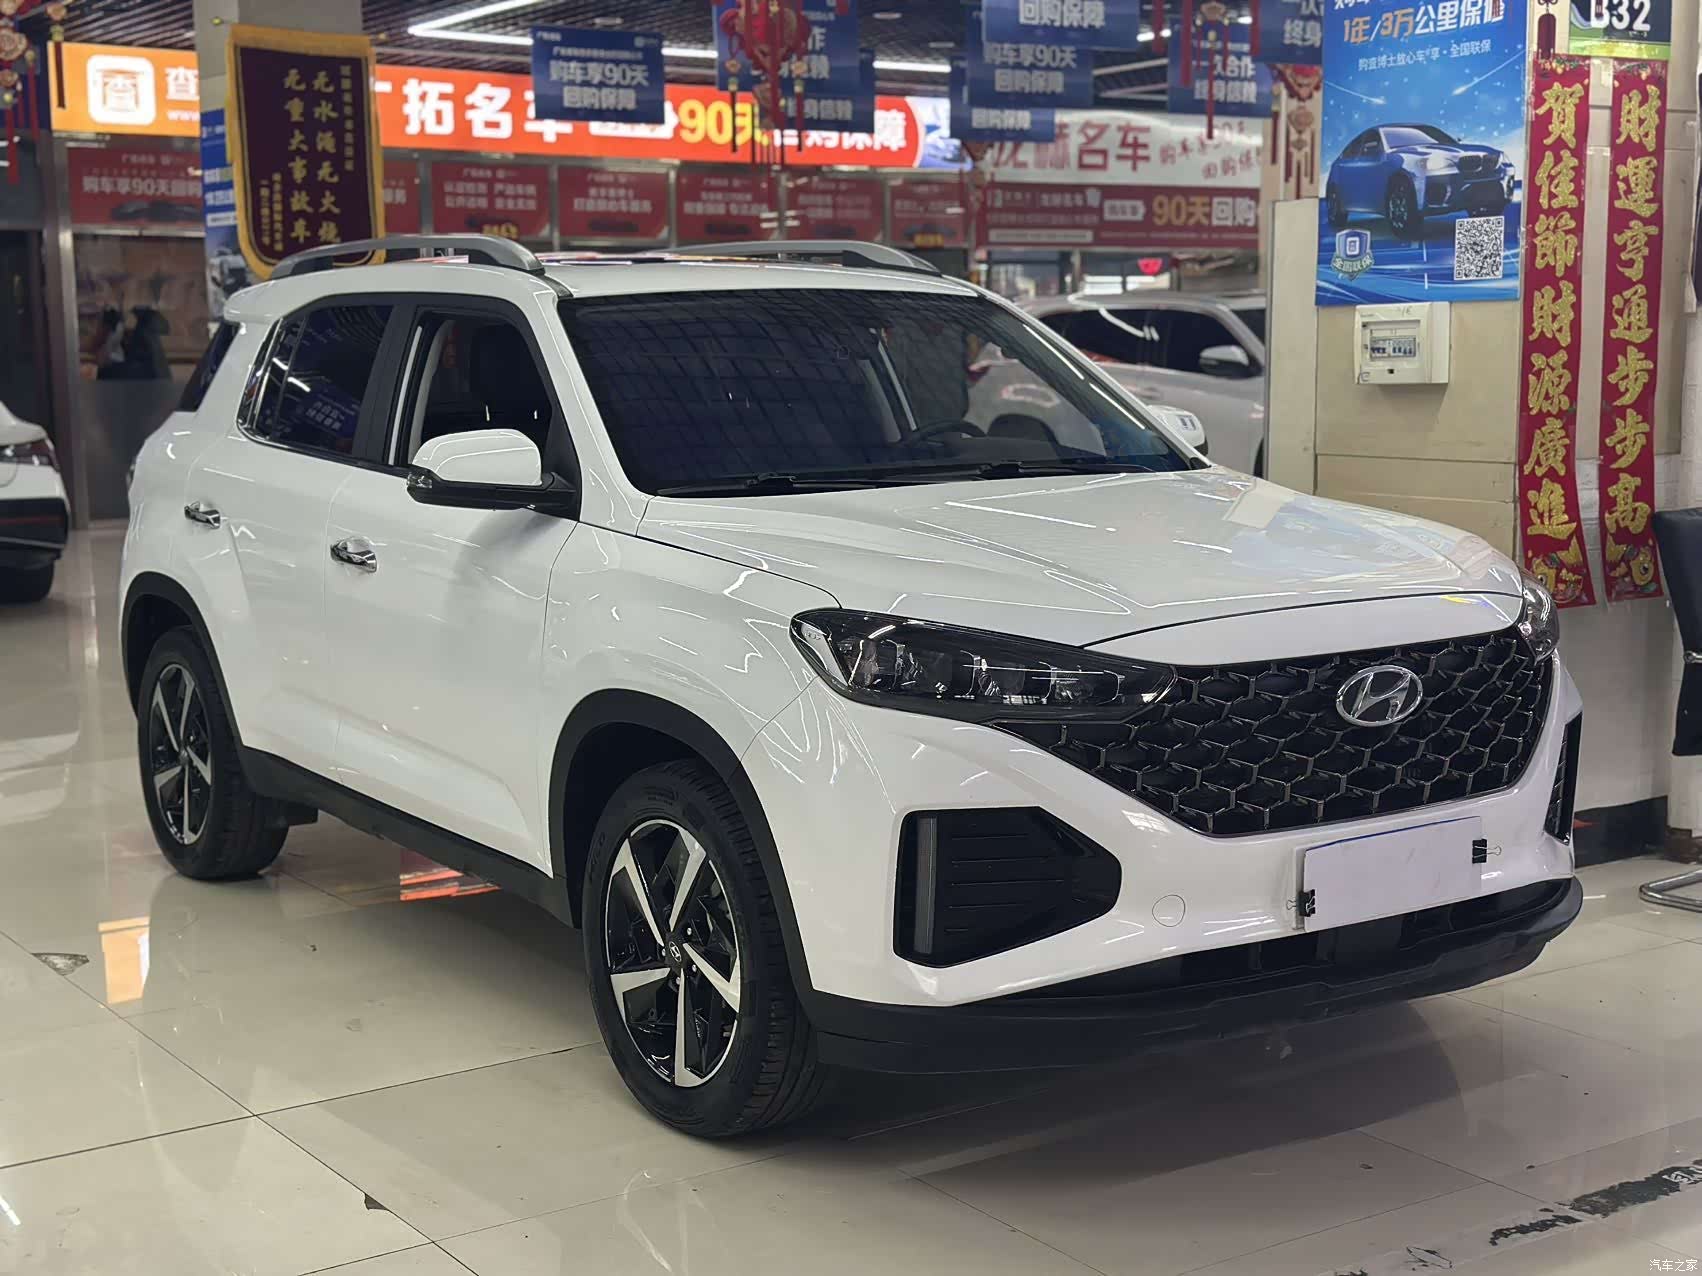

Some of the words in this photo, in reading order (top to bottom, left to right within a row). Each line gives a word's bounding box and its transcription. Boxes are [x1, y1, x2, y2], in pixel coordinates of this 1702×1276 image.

[371, 77, 574, 143] 拓名车
[1523, 82, 1585, 540] 賀佳節財源廣進
[1604, 85, 1660, 535] 財運亨通步步高
